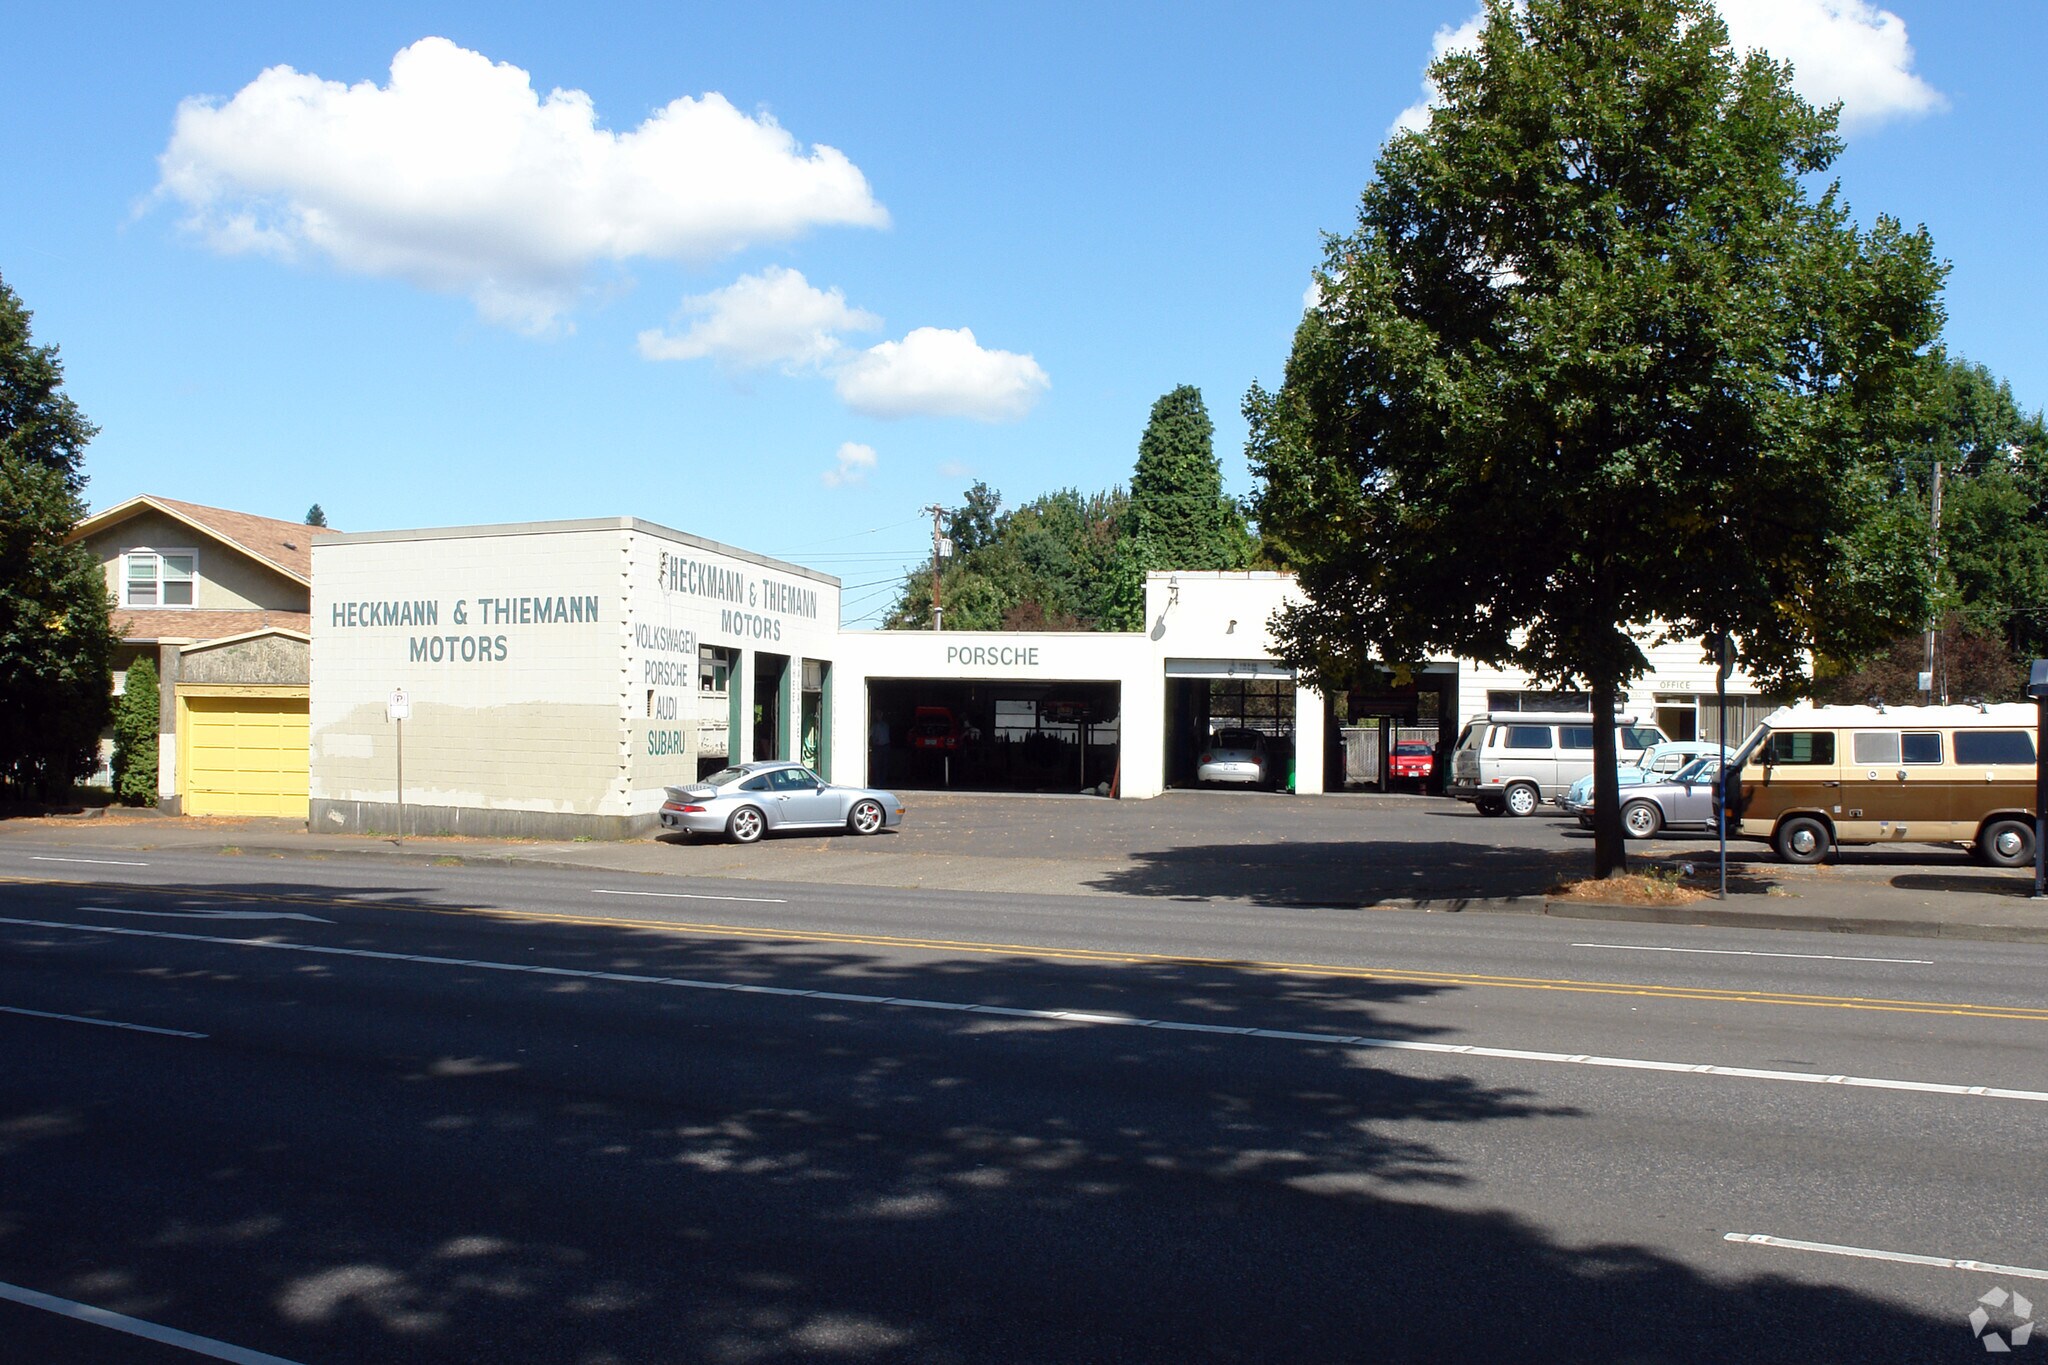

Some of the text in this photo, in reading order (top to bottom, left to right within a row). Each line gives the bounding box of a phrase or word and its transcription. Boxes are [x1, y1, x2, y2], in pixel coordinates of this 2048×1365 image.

[669, 556, 817, 619] HECKMANN & THIEMANN
[332, 596, 599, 627] HECKMANN & THIEMANN
[635, 622, 696, 655] VOLKSWAGEN
[721, 610, 780, 641] MOTORS
[410, 635, 508, 662] MOTORS
[947, 646, 1039, 666] PORSCHE
[645, 661, 688, 687] PORSCHE
[1660, 681, 1691, 689] OFFICE
[657, 696, 677, 720] AUDI
[648, 730, 685, 756] SUBARU
